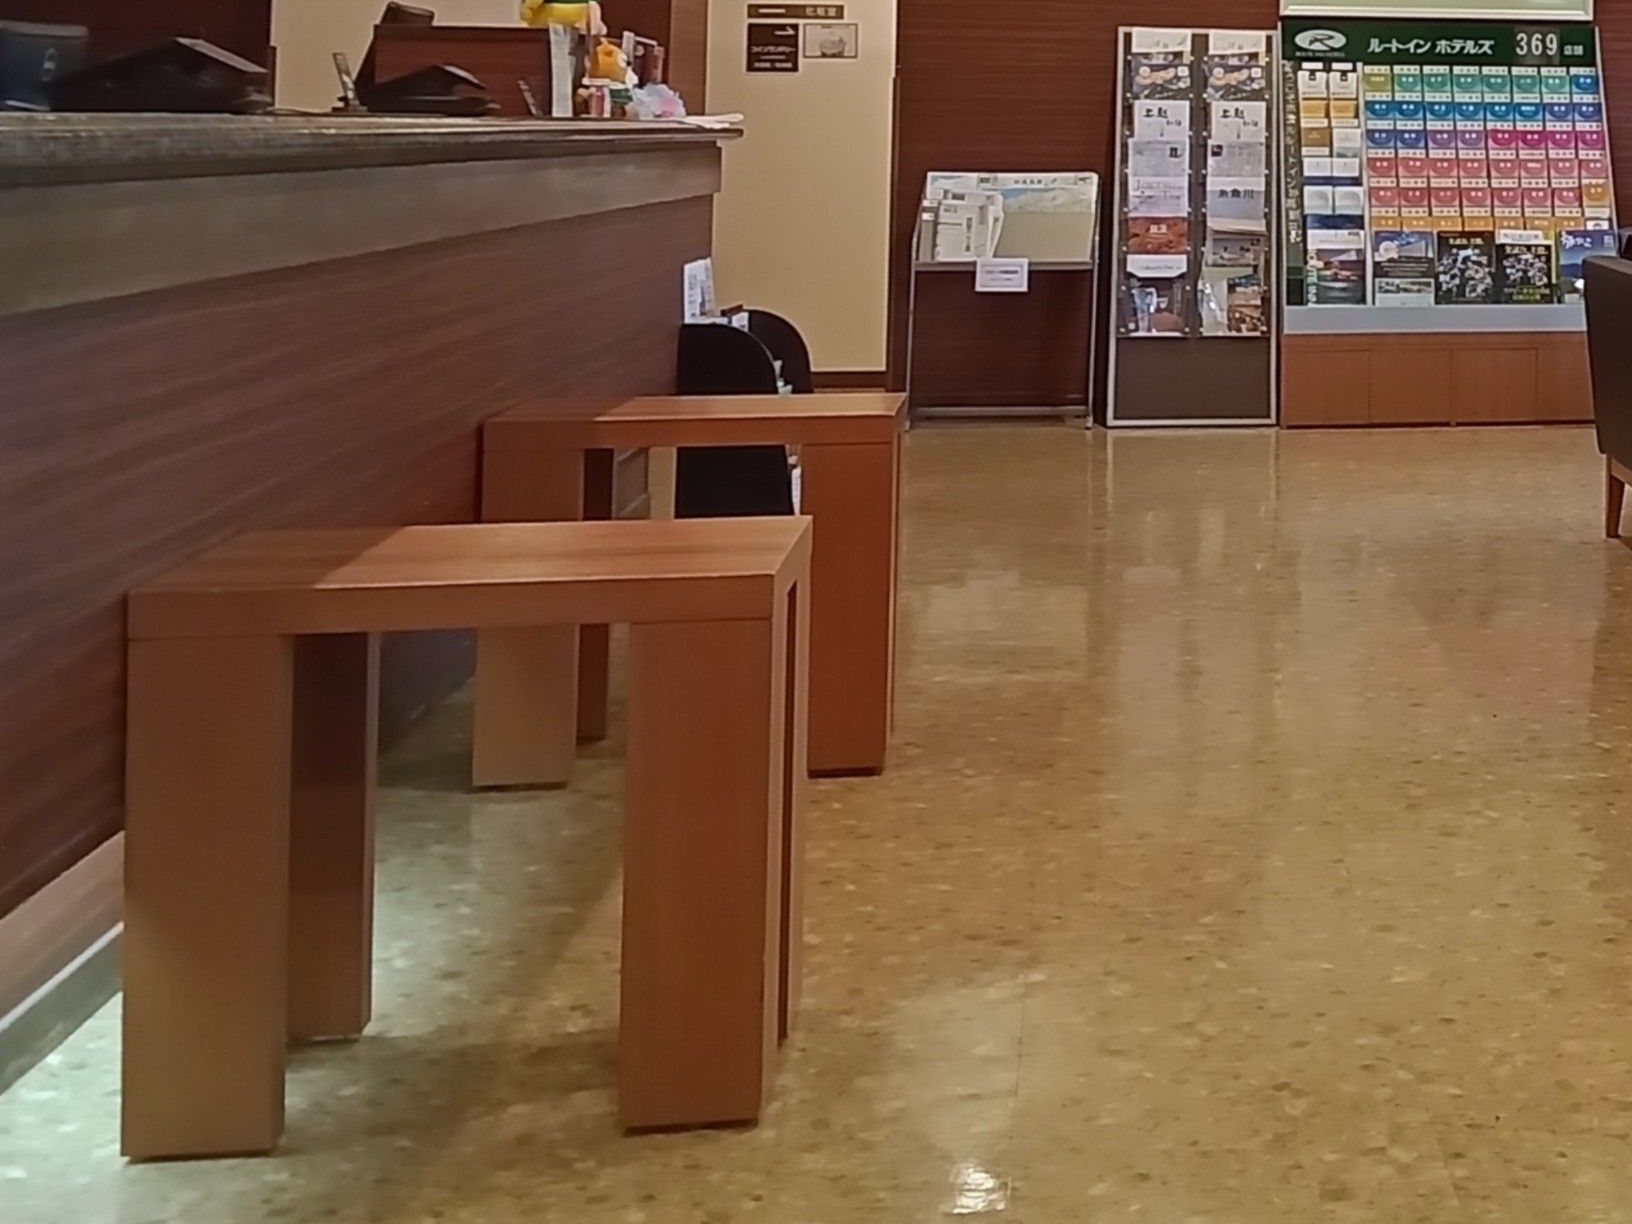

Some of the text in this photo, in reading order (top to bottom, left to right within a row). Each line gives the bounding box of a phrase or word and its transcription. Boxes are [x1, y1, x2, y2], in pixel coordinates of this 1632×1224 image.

[1367, 38, 1431, 54] ルートイン
[1435, 39, 1495, 55] ホテルズ
[1516, 33, 1558, 56] 369
